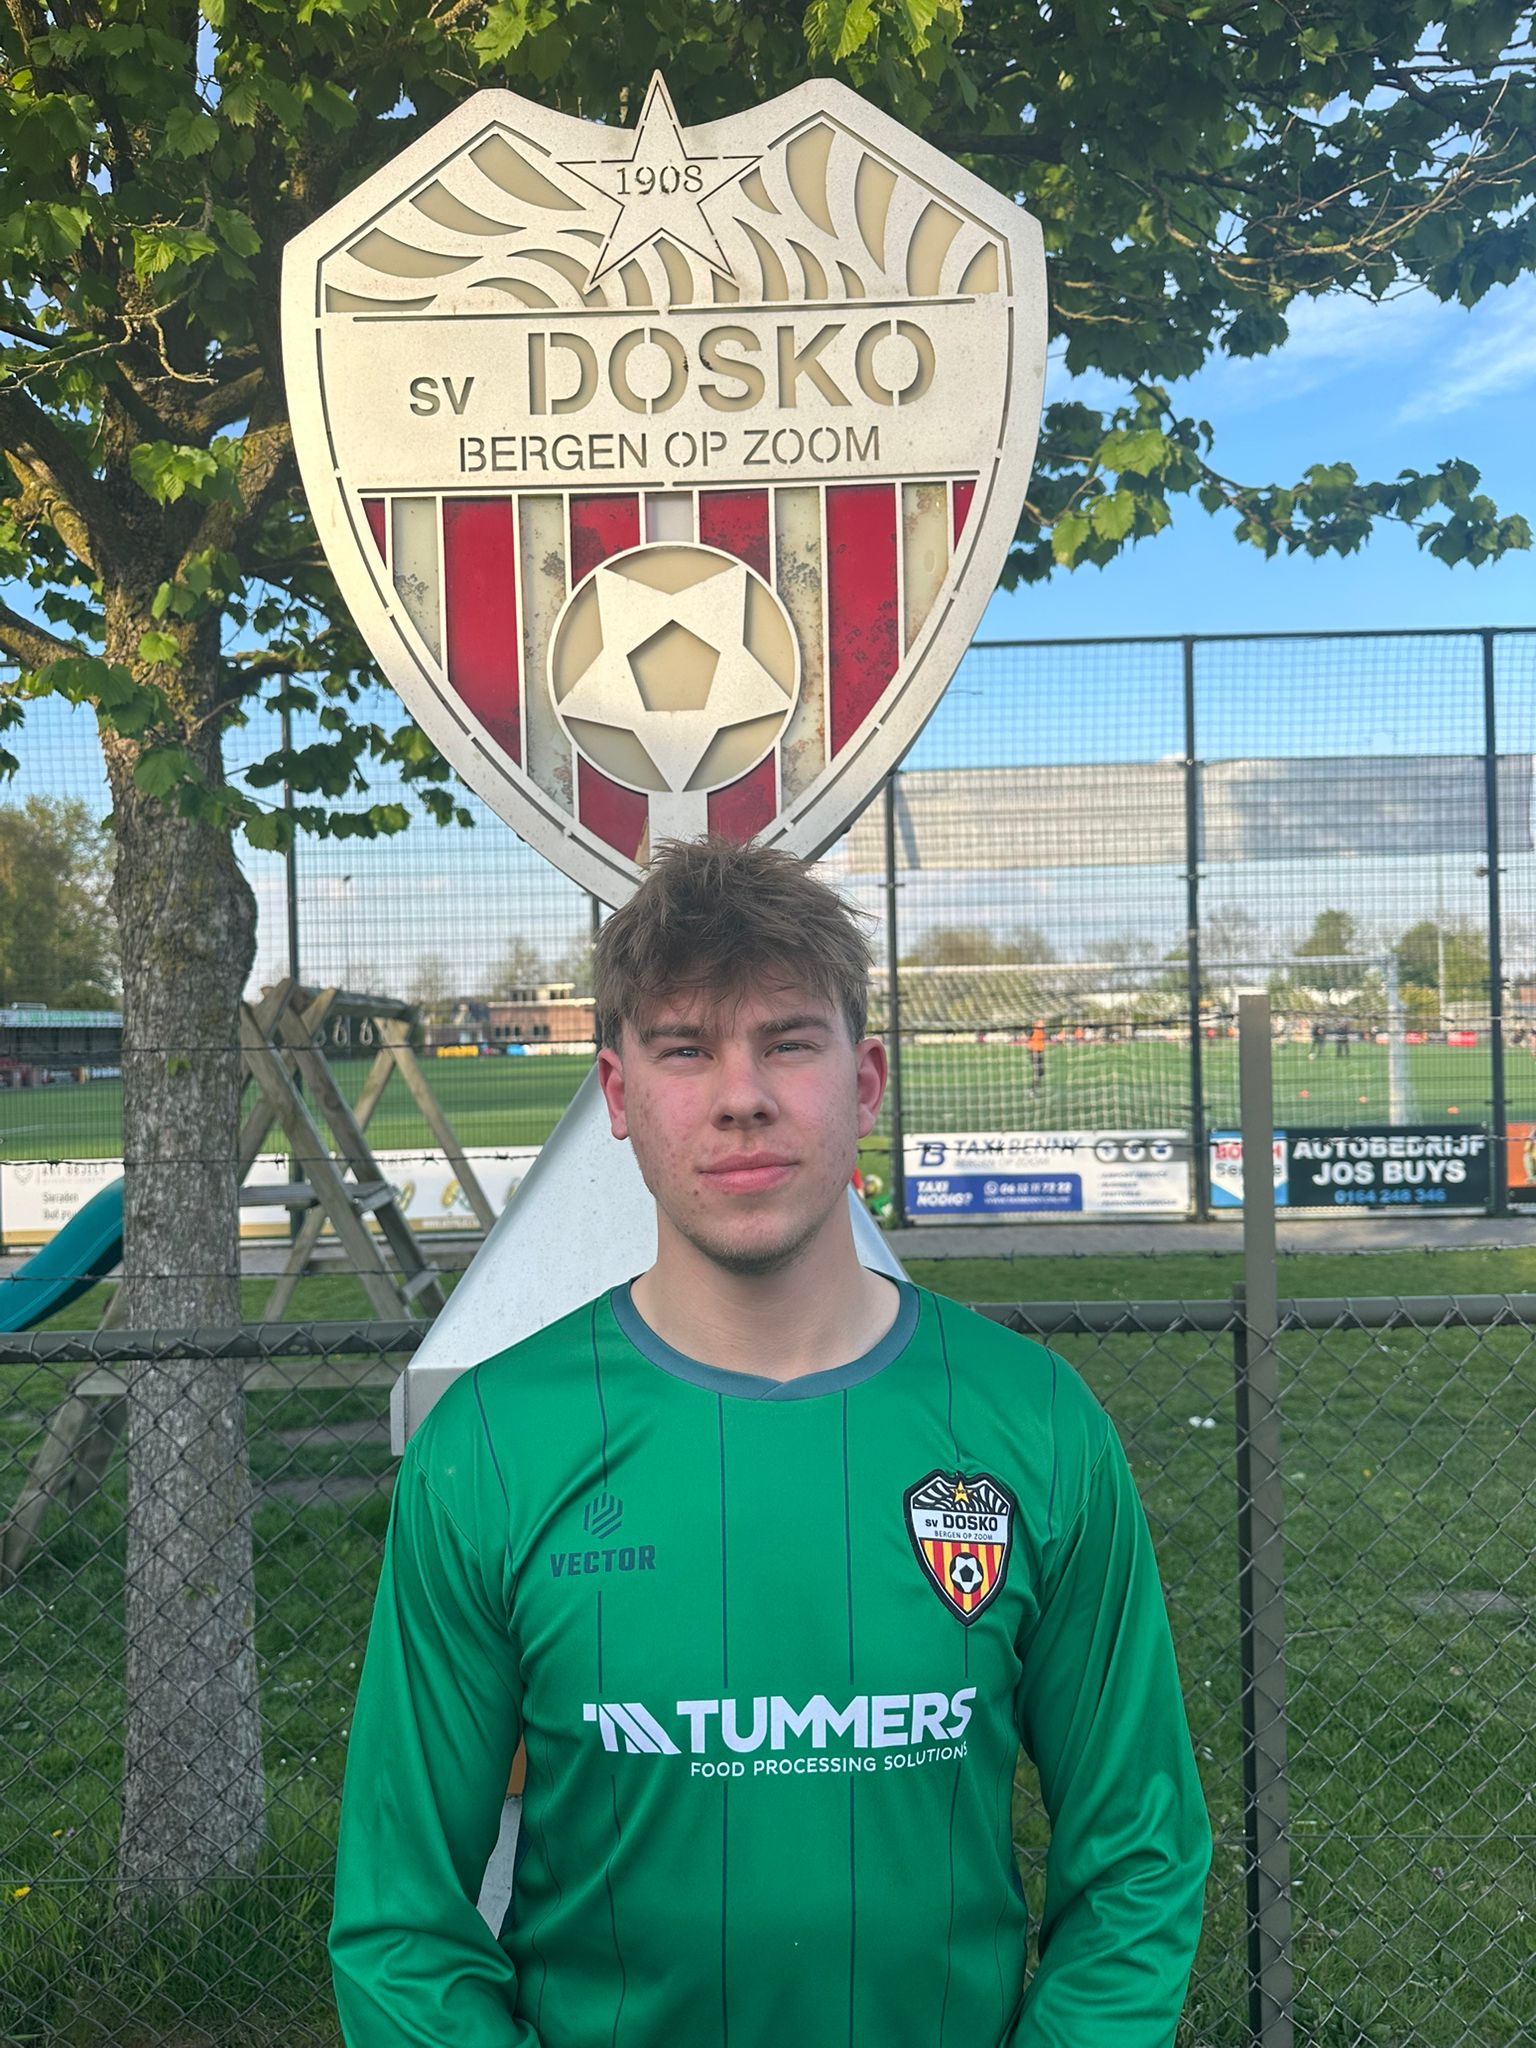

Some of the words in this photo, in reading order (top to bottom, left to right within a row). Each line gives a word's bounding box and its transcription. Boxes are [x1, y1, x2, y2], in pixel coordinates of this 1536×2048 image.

[616, 164, 704, 195] 1908
[409, 376, 475, 416] SV
[528, 319, 937, 415] DOSKO
[459, 432, 648, 473] BERGEN
[664, 431, 728, 468] OP
[743, 425, 880, 466] ZOOM
[1292, 1134, 1487, 1160] AUTOBEDRIJF
[1311, 1160, 1376, 1186] JOS
[1382, 1159, 1467, 1184] BUYS
[925, 1518, 938, 1528] SV
[942, 1513, 998, 1532] DOSKO
[934, 1530, 961, 1539] BERGEN
[974, 1533, 993, 1541] ZOOM
[550, 1544, 656, 1578] VECTOR
[676, 1686, 977, 1754] TUMMERS
[690, 1761, 745, 1778] FOOD
[753, 1756, 877, 1776] PROCESSING
[884, 1740, 967, 1771] SOLUTIONS
